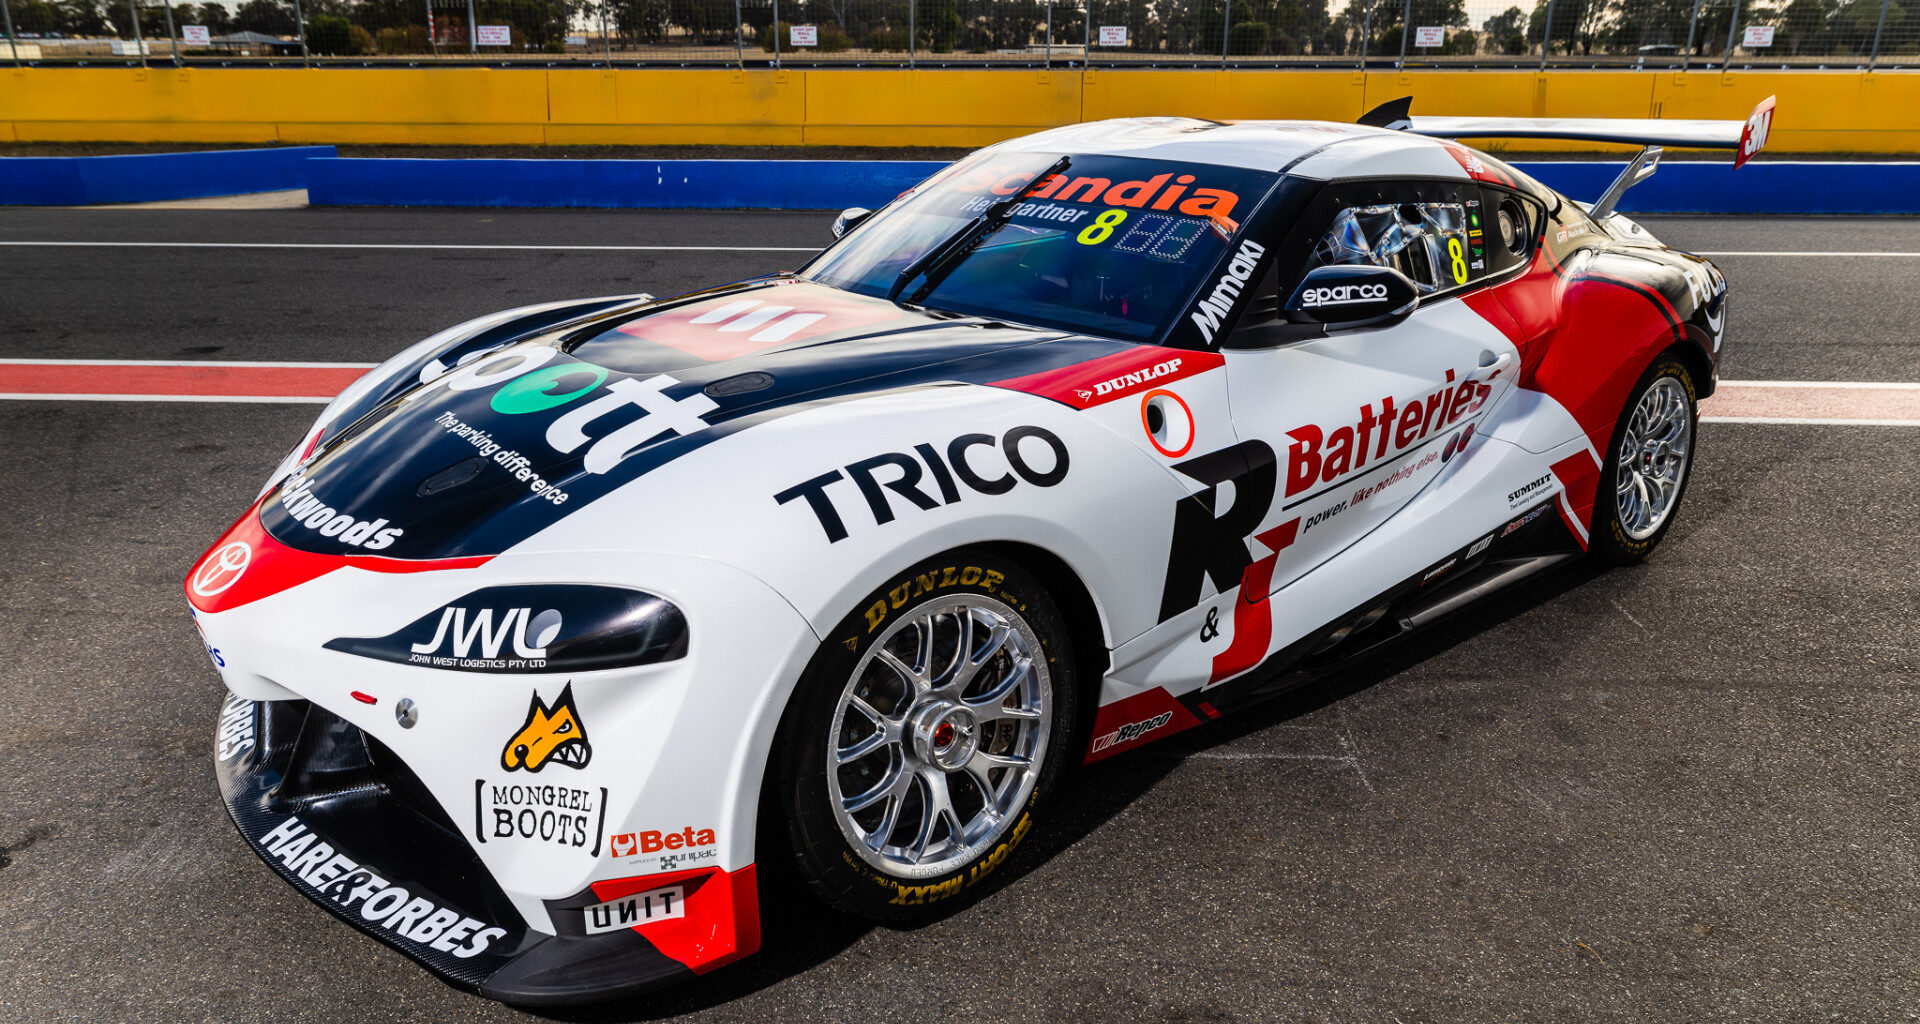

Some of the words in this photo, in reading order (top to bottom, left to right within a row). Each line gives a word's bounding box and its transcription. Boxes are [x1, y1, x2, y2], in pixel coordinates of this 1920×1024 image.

[1745, 110, 1771, 155] 3M
[956, 165, 1239, 217] Scandia
[959, 195, 1090, 223] Hegartner
[1077, 209, 1128, 245] 8
[1448, 237, 1467, 285] 8
[1191, 239, 1266, 346] Mimaki
[1302, 284, 1388, 307] sparco
[1093, 358, 1183, 396] DUNLOP
[1284, 367, 1501, 499] Batteries
[435, 411, 459, 431] The
[449, 418, 502, 458] parking
[493, 449, 570, 505] difference
[773, 425, 1070, 544] TRICO
[1349, 486, 1374, 508] like
[1373, 461, 1416, 495] nothing
[1508, 472, 1552, 502] SUMMIT
[1157, 438, 1278, 626] R
[864, 566, 1005, 634] DUNLOP
[1207, 516, 1302, 686] J
[411, 607, 547, 659] JWL
[1200, 605, 1220, 644] &
[409, 653, 431, 664] JOHN
[433, 656, 458, 667] WEST
[459, 658, 506, 669] LOGISTICS
[508, 659, 526, 669] PTY
[529, 659, 546, 668] LTD
[1113, 710, 1173, 746] Repco
[492, 785, 592, 812] MONGREL
[493, 808, 588, 848] BOOTS
[639, 826, 716, 854] Beta
